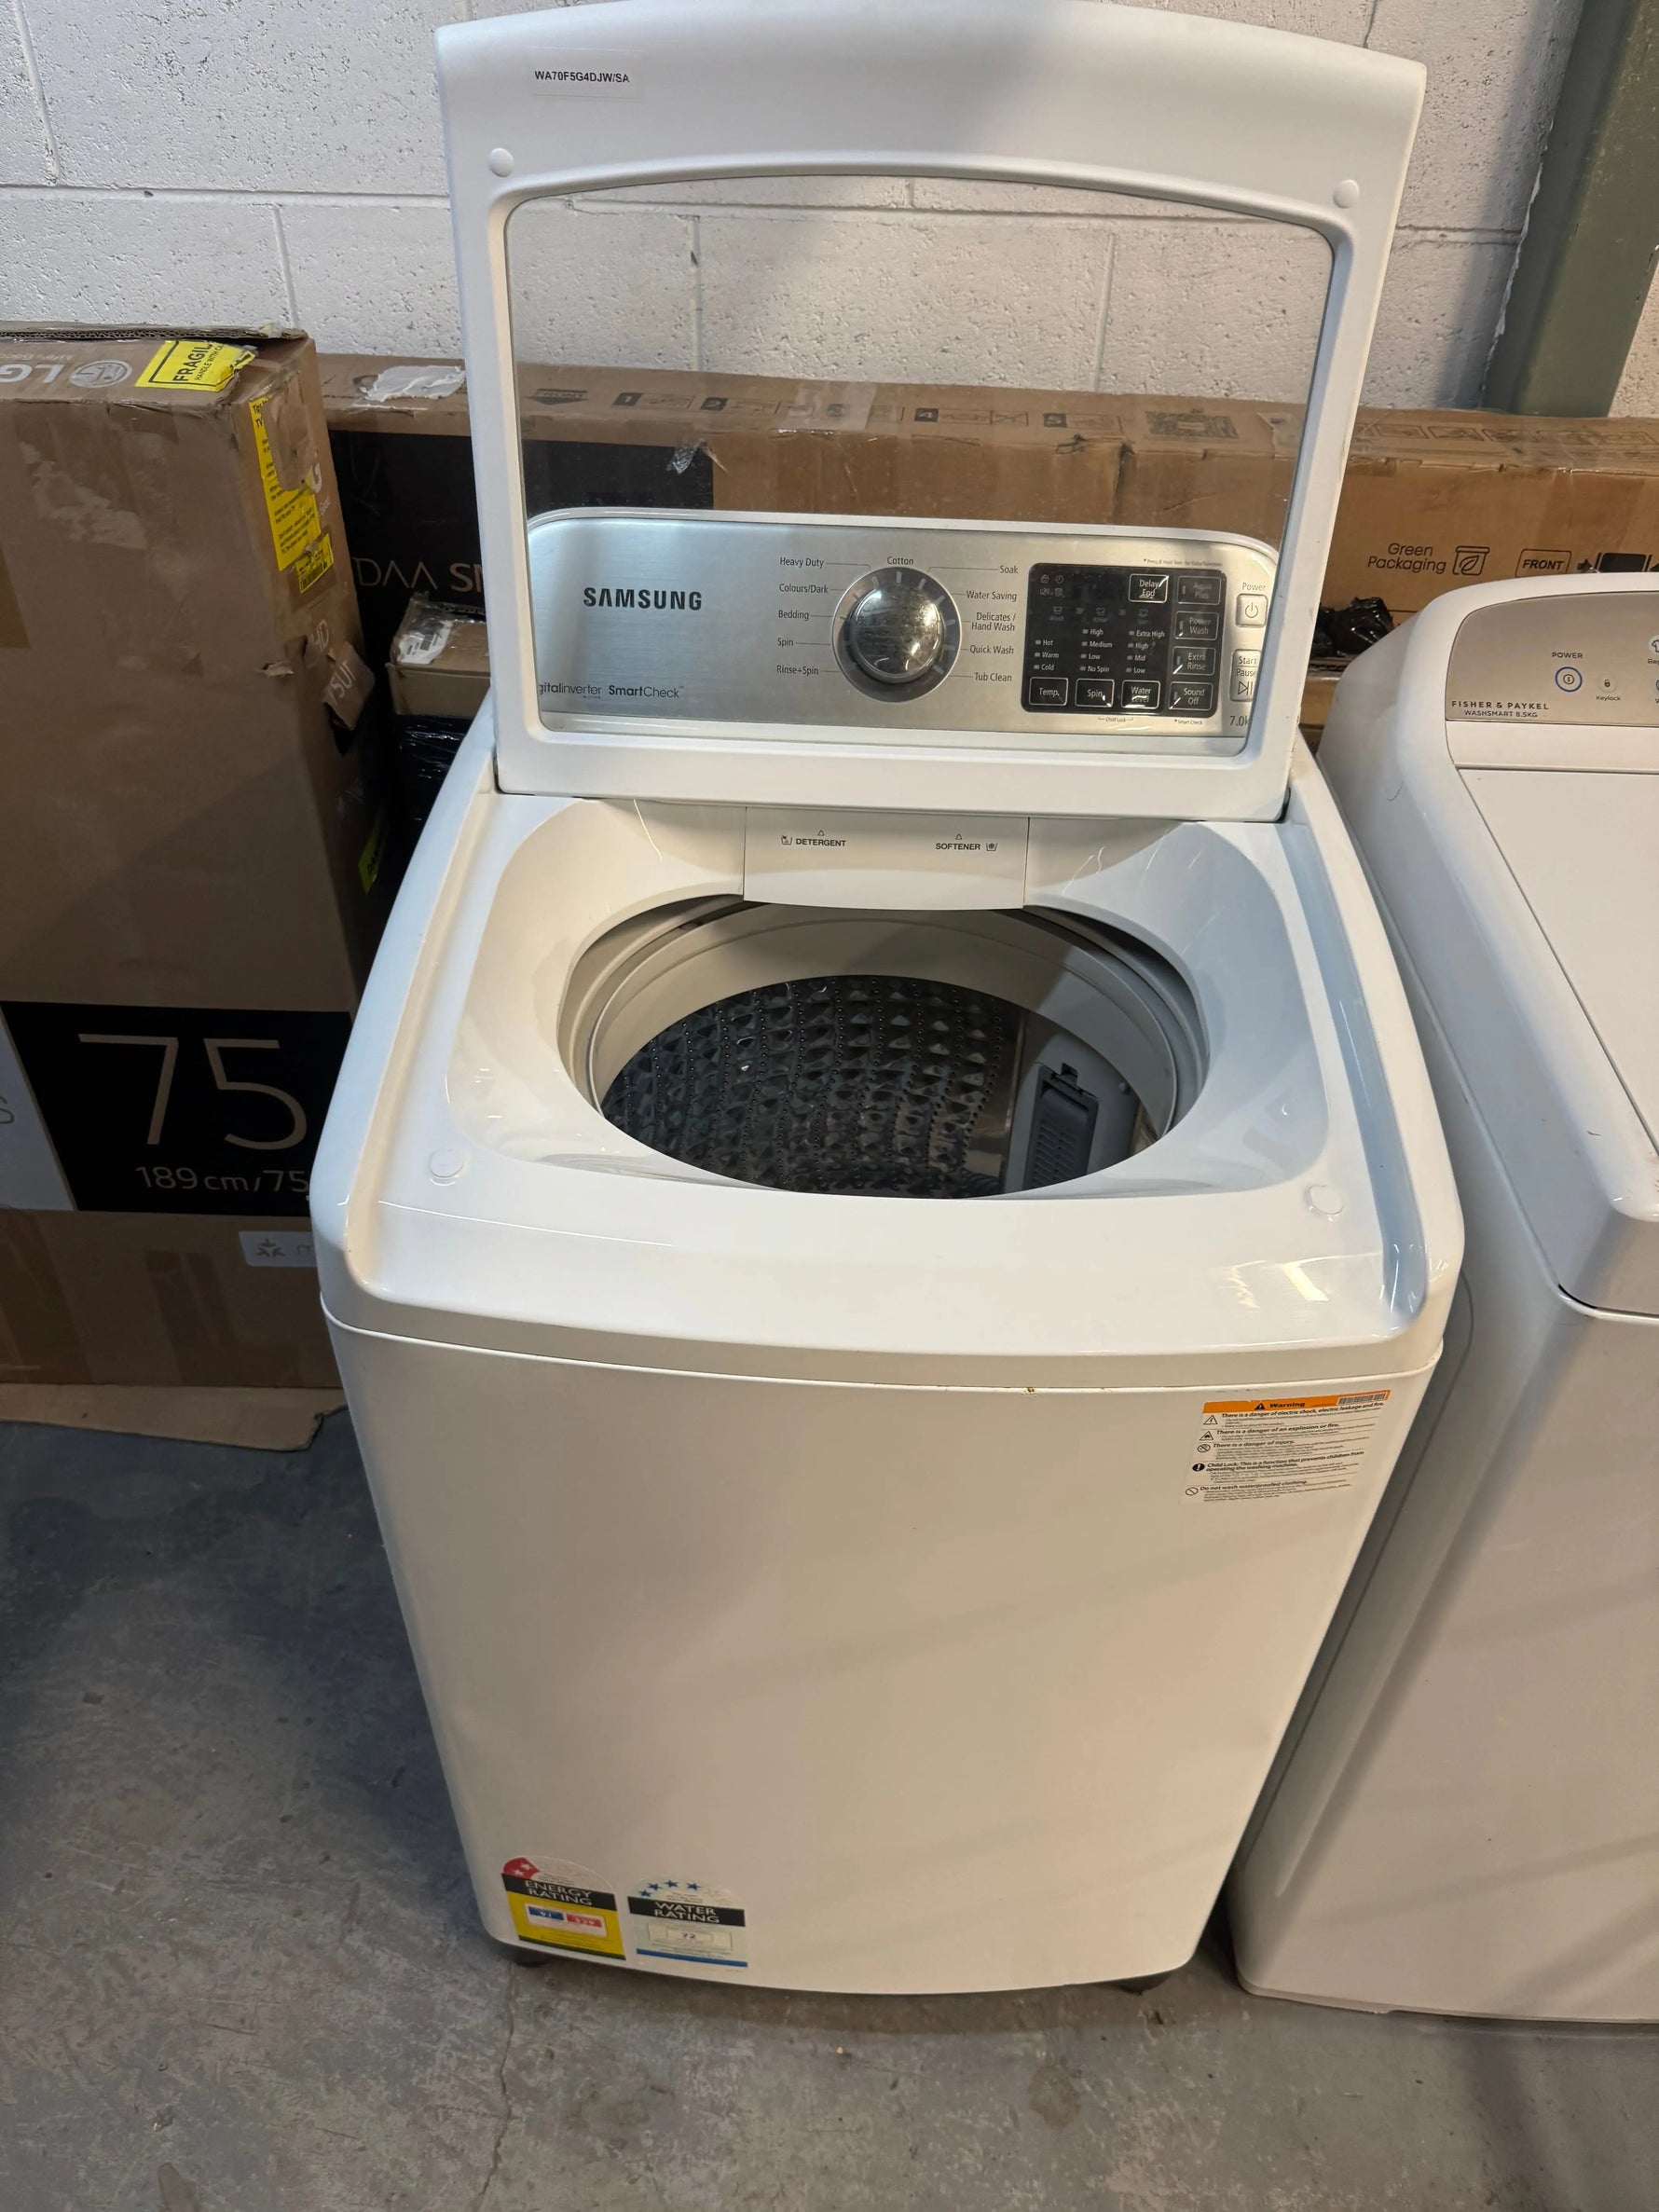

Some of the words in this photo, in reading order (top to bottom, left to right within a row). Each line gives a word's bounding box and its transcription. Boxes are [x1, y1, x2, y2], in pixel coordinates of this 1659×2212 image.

[535, 70, 630, 83] WA70F5G4DJW/SA
[0, 364, 65, 383] LG
[1388, 543, 1433, 557] Green
[779, 557, 803, 568] Heavy
[805, 558, 824, 569] Duty
[886, 556, 914, 566] Cotton
[1367, 556, 1446, 574] Packaging
[1522, 559, 1564, 570] FRONT
[1000, 565, 1019, 574] Soak
[778, 584, 829, 594] Colours/Dark
[1139, 579, 1160, 590] Delay
[1242, 583, 1266, 593] Power
[583, 586, 702, 611] SAMSUNG
[966, 590, 990, 599] Water
[992, 592, 1017, 602] Saving
[1142, 589, 1156, 598] End
[778, 610, 809, 622] Bedding
[976, 612, 1009, 623] Delicates
[1189, 617, 1212, 626] Power
[971, 622, 992, 631] Hand
[994, 623, 1015, 632] Wash
[1189, 625, 1209, 635] Wash
[1090, 628, 1104, 638] High
[1136, 629, 1151, 638] Extra
[1152, 630, 1166, 639] High
[777, 637, 794, 648] Spin
[1089, 640, 1114, 649] Medium
[1134, 642, 1149, 652] High
[969, 645, 991, 655] Quick
[993, 646, 1014, 654] Wash
[1088, 653, 1101, 661] Low
[1238, 655, 1257, 666] Start
[1551, 652, 1584, 660] POWER
[776, 665, 819, 677] Rinse+Spin
[1040, 663, 1055, 671] Cold
[1096, 666, 1110, 675] Spin
[1186, 662, 1206, 671] Rinse
[974, 672, 988, 682] Tub
[990, 672, 1012, 682] Clean
[1038, 687, 1061, 698] Temp.
[1087, 689, 1104, 700] Spin
[1130, 686, 1152, 695] Water
[1183, 688, 1205, 697] Sound
[1187, 696, 1200, 706] Off
[1451, 700, 1492, 708] FISHER
[1507, 702, 1549, 710] PAYKEL
[1463, 709, 1514, 718] WASHSMART
[795, 838, 846, 847] DETERGENT
[935, 842, 981, 851] SOFTENER
[77, 1033, 308, 1150] 75
[1269, 1402, 1306, 1410] Warning
[526, 1879, 593, 1898] ENERGY
[528, 1888, 594, 1907] RATING
[655, 1901, 717, 1916] WATER
[653, 1908, 720, 1924] RATING
